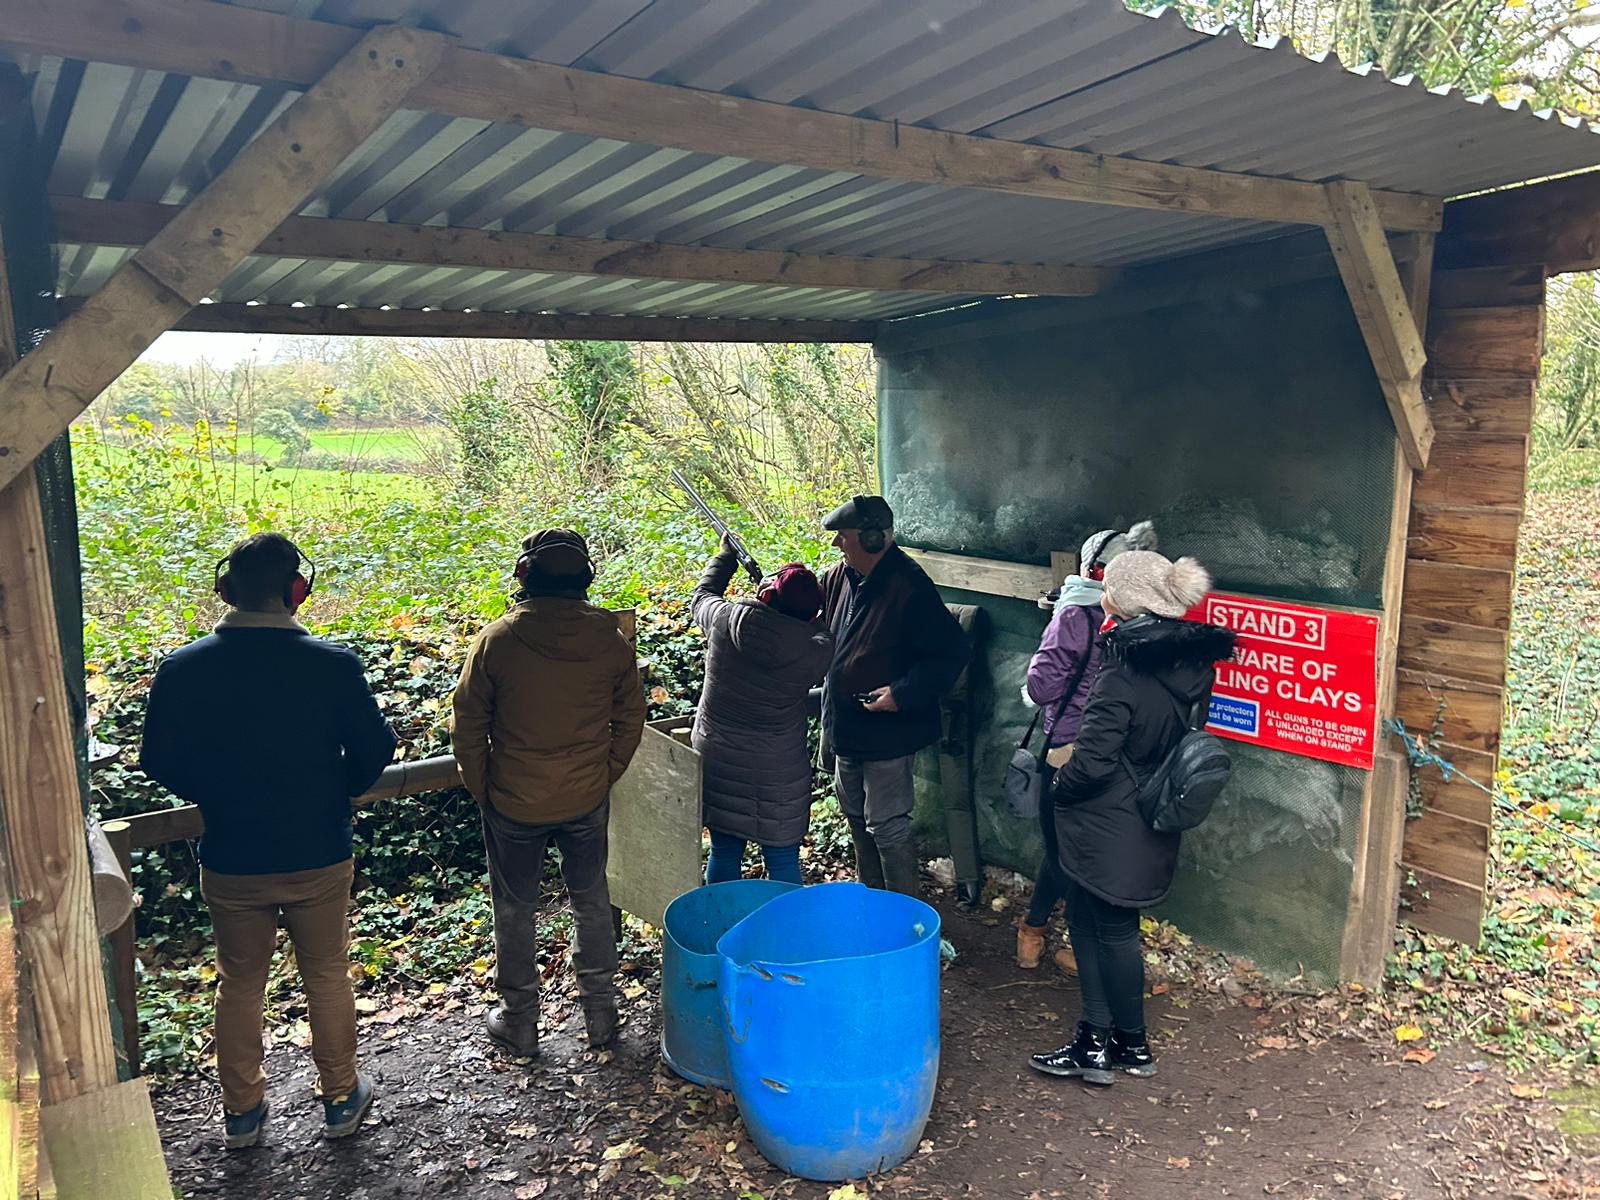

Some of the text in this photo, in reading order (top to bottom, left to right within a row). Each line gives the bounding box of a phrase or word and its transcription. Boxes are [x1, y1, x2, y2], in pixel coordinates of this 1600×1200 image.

[1212, 605, 1319, 642] STAND 3
[1229, 646, 1338, 682] WARE OF
[1215, 667, 1362, 713] LING CLAYS
[1208, 711, 1252, 726] ust be worn
[1216, 703, 1254, 717] protectors
[1264, 708, 1367, 737] ALL GUNS TO BE OPEN
[1267, 718, 1363, 745] & UNLOADED EXCEPT
[1276, 729, 1351, 752] WHEN ON STAND
